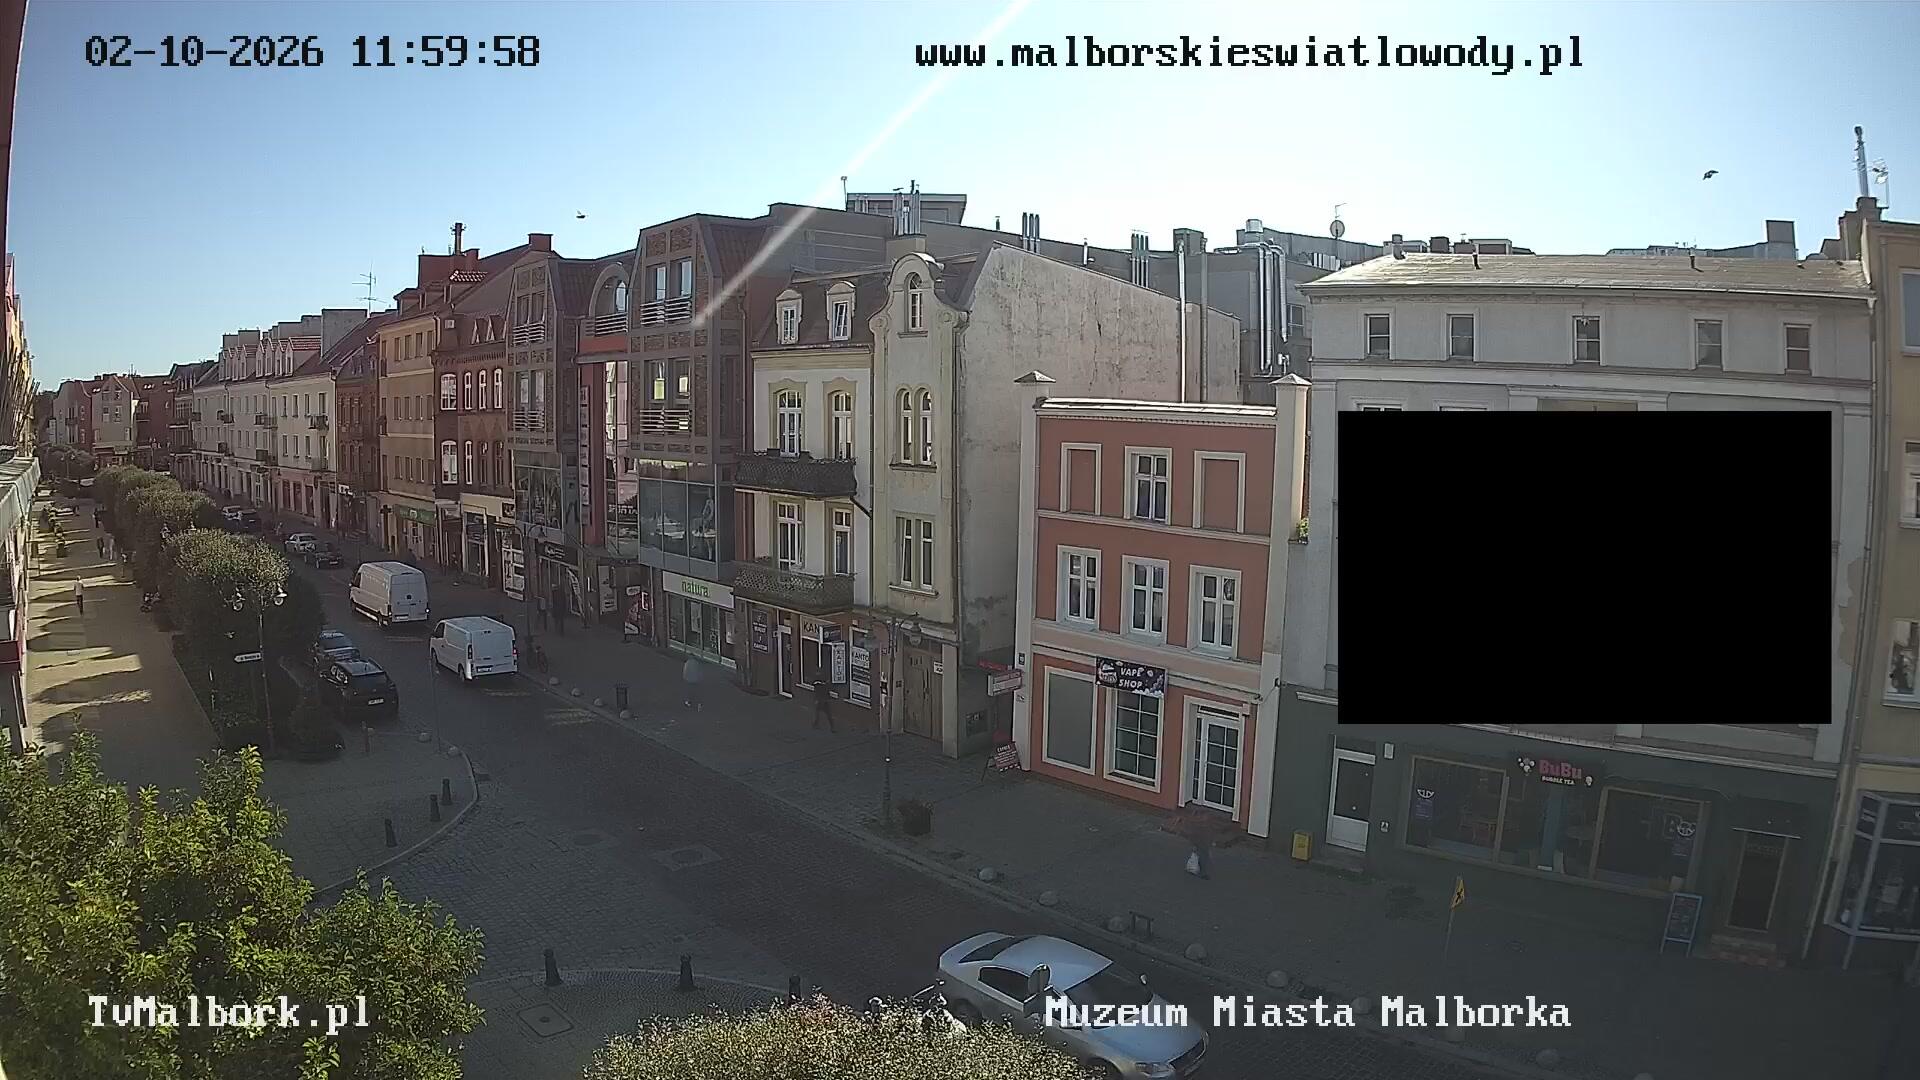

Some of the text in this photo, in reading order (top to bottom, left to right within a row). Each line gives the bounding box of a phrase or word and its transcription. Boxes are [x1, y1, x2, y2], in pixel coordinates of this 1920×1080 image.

[1120, 667, 1142, 677] VAPE
[1118, 679, 1143, 689] SHOP
[1540, 760, 1582, 779] BuBu
